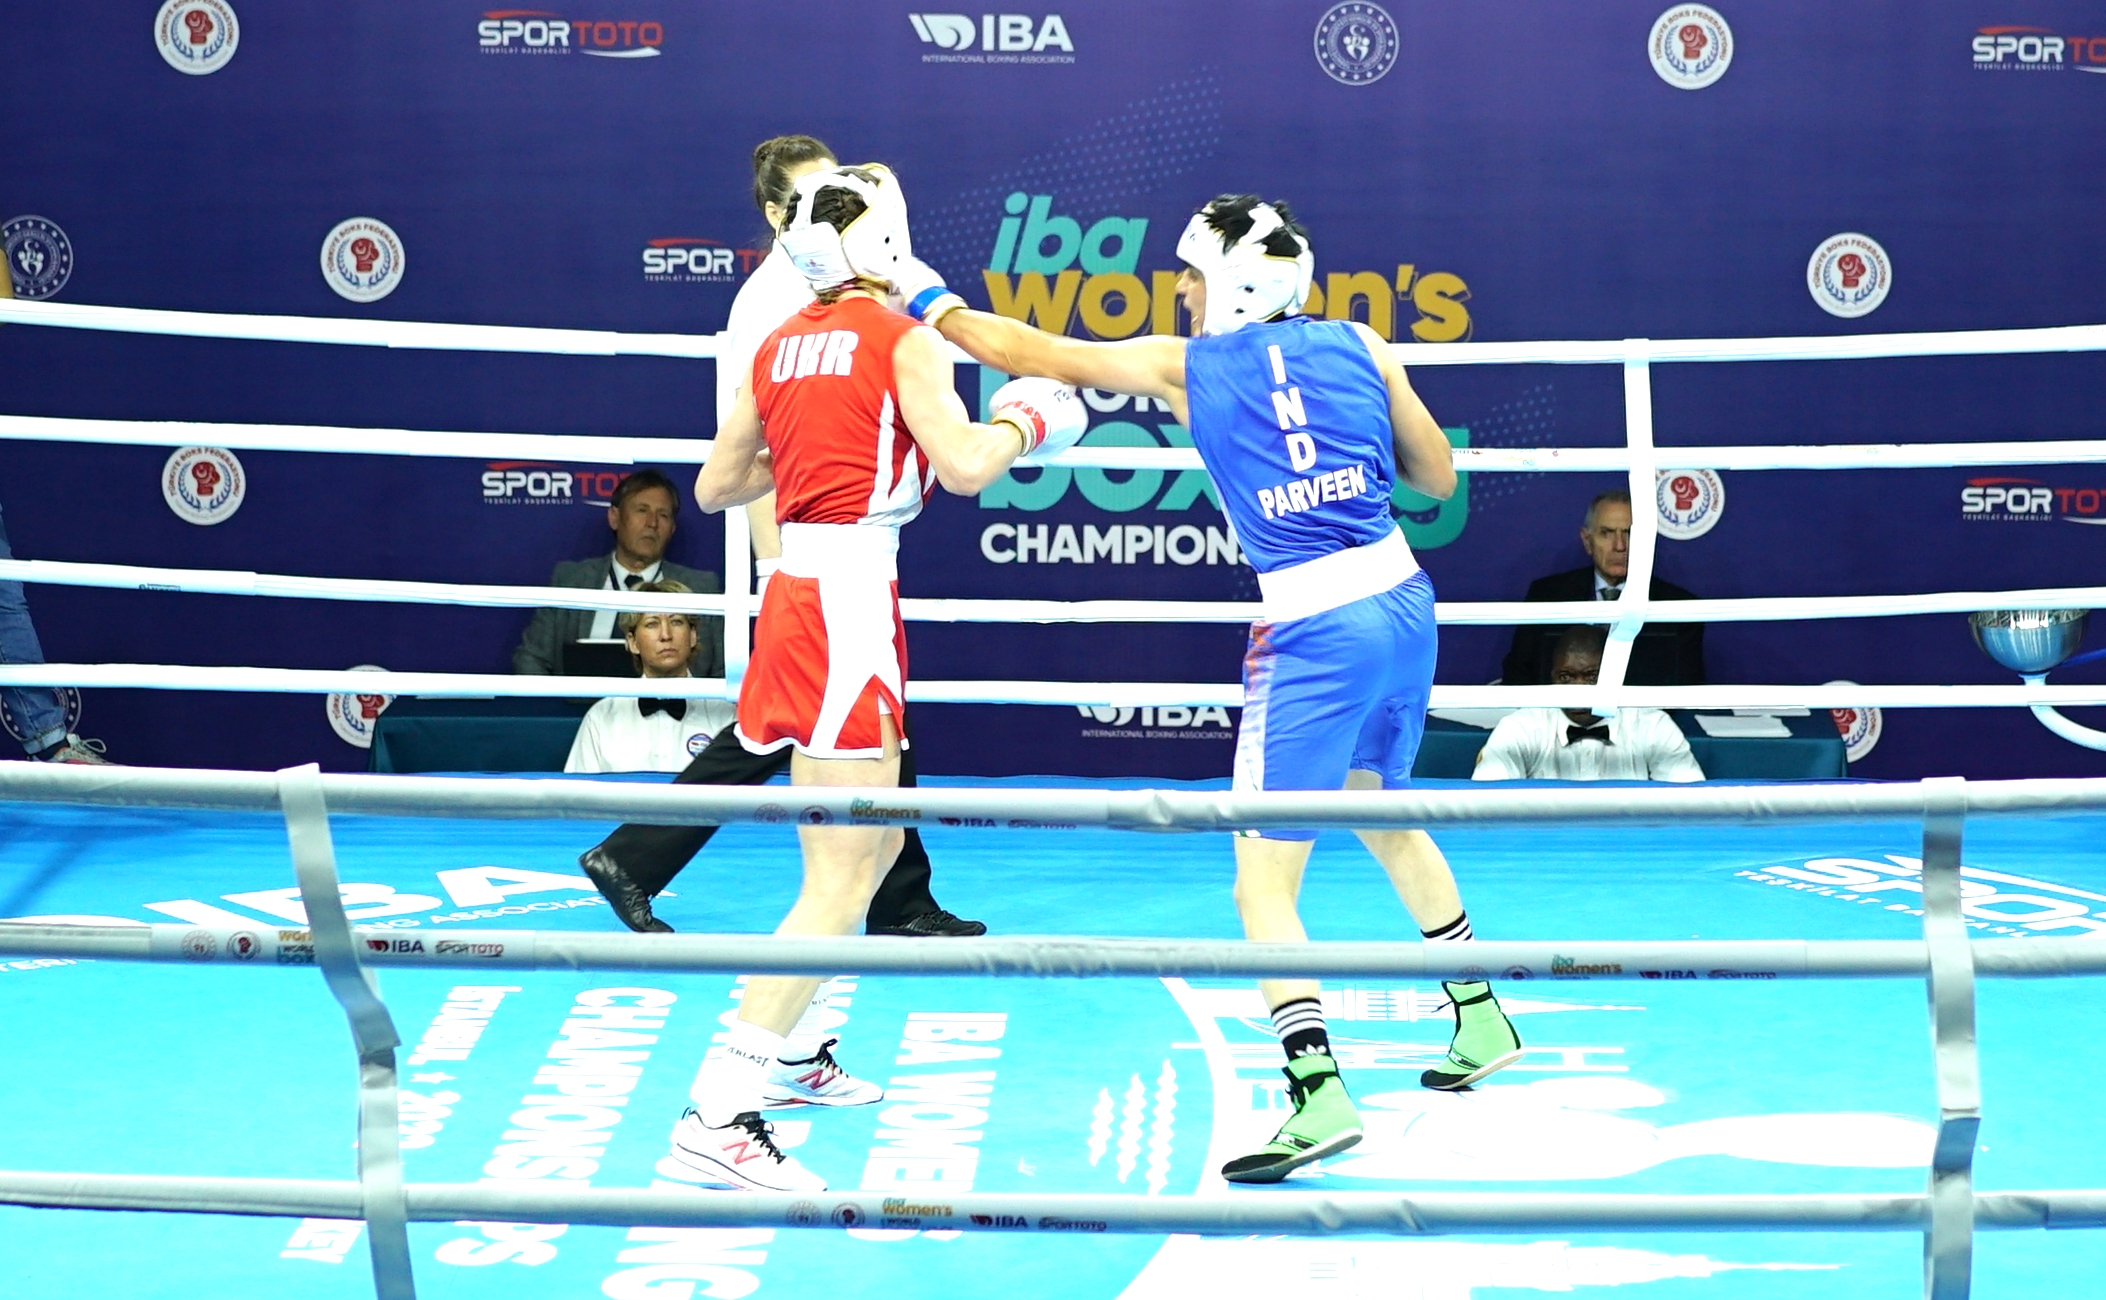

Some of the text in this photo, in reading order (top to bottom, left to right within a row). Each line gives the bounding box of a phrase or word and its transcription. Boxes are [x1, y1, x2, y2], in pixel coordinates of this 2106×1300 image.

[982, 14, 1075, 51] IBA
[922, 55, 1076, 64] INTERNATIONAL BOXING ASSOCIATION
[990, 192, 1149, 275] iba
[771, 329, 859, 384] UKR
[1257, 464, 1367, 520] PARVEEN
[980, 523, 1251, 567] CHAMPION
[1141, 706, 1233, 727] IBA
[1082, 730, 1233, 740] INTERNATIONAL BOXING ASSOCIATION
[391, 939, 425, 953] IBA
[903, 1012, 1009, 1066] IBA
[882, 1202, 953, 1217] women's
[995, 1215, 1029, 1228] IBA
